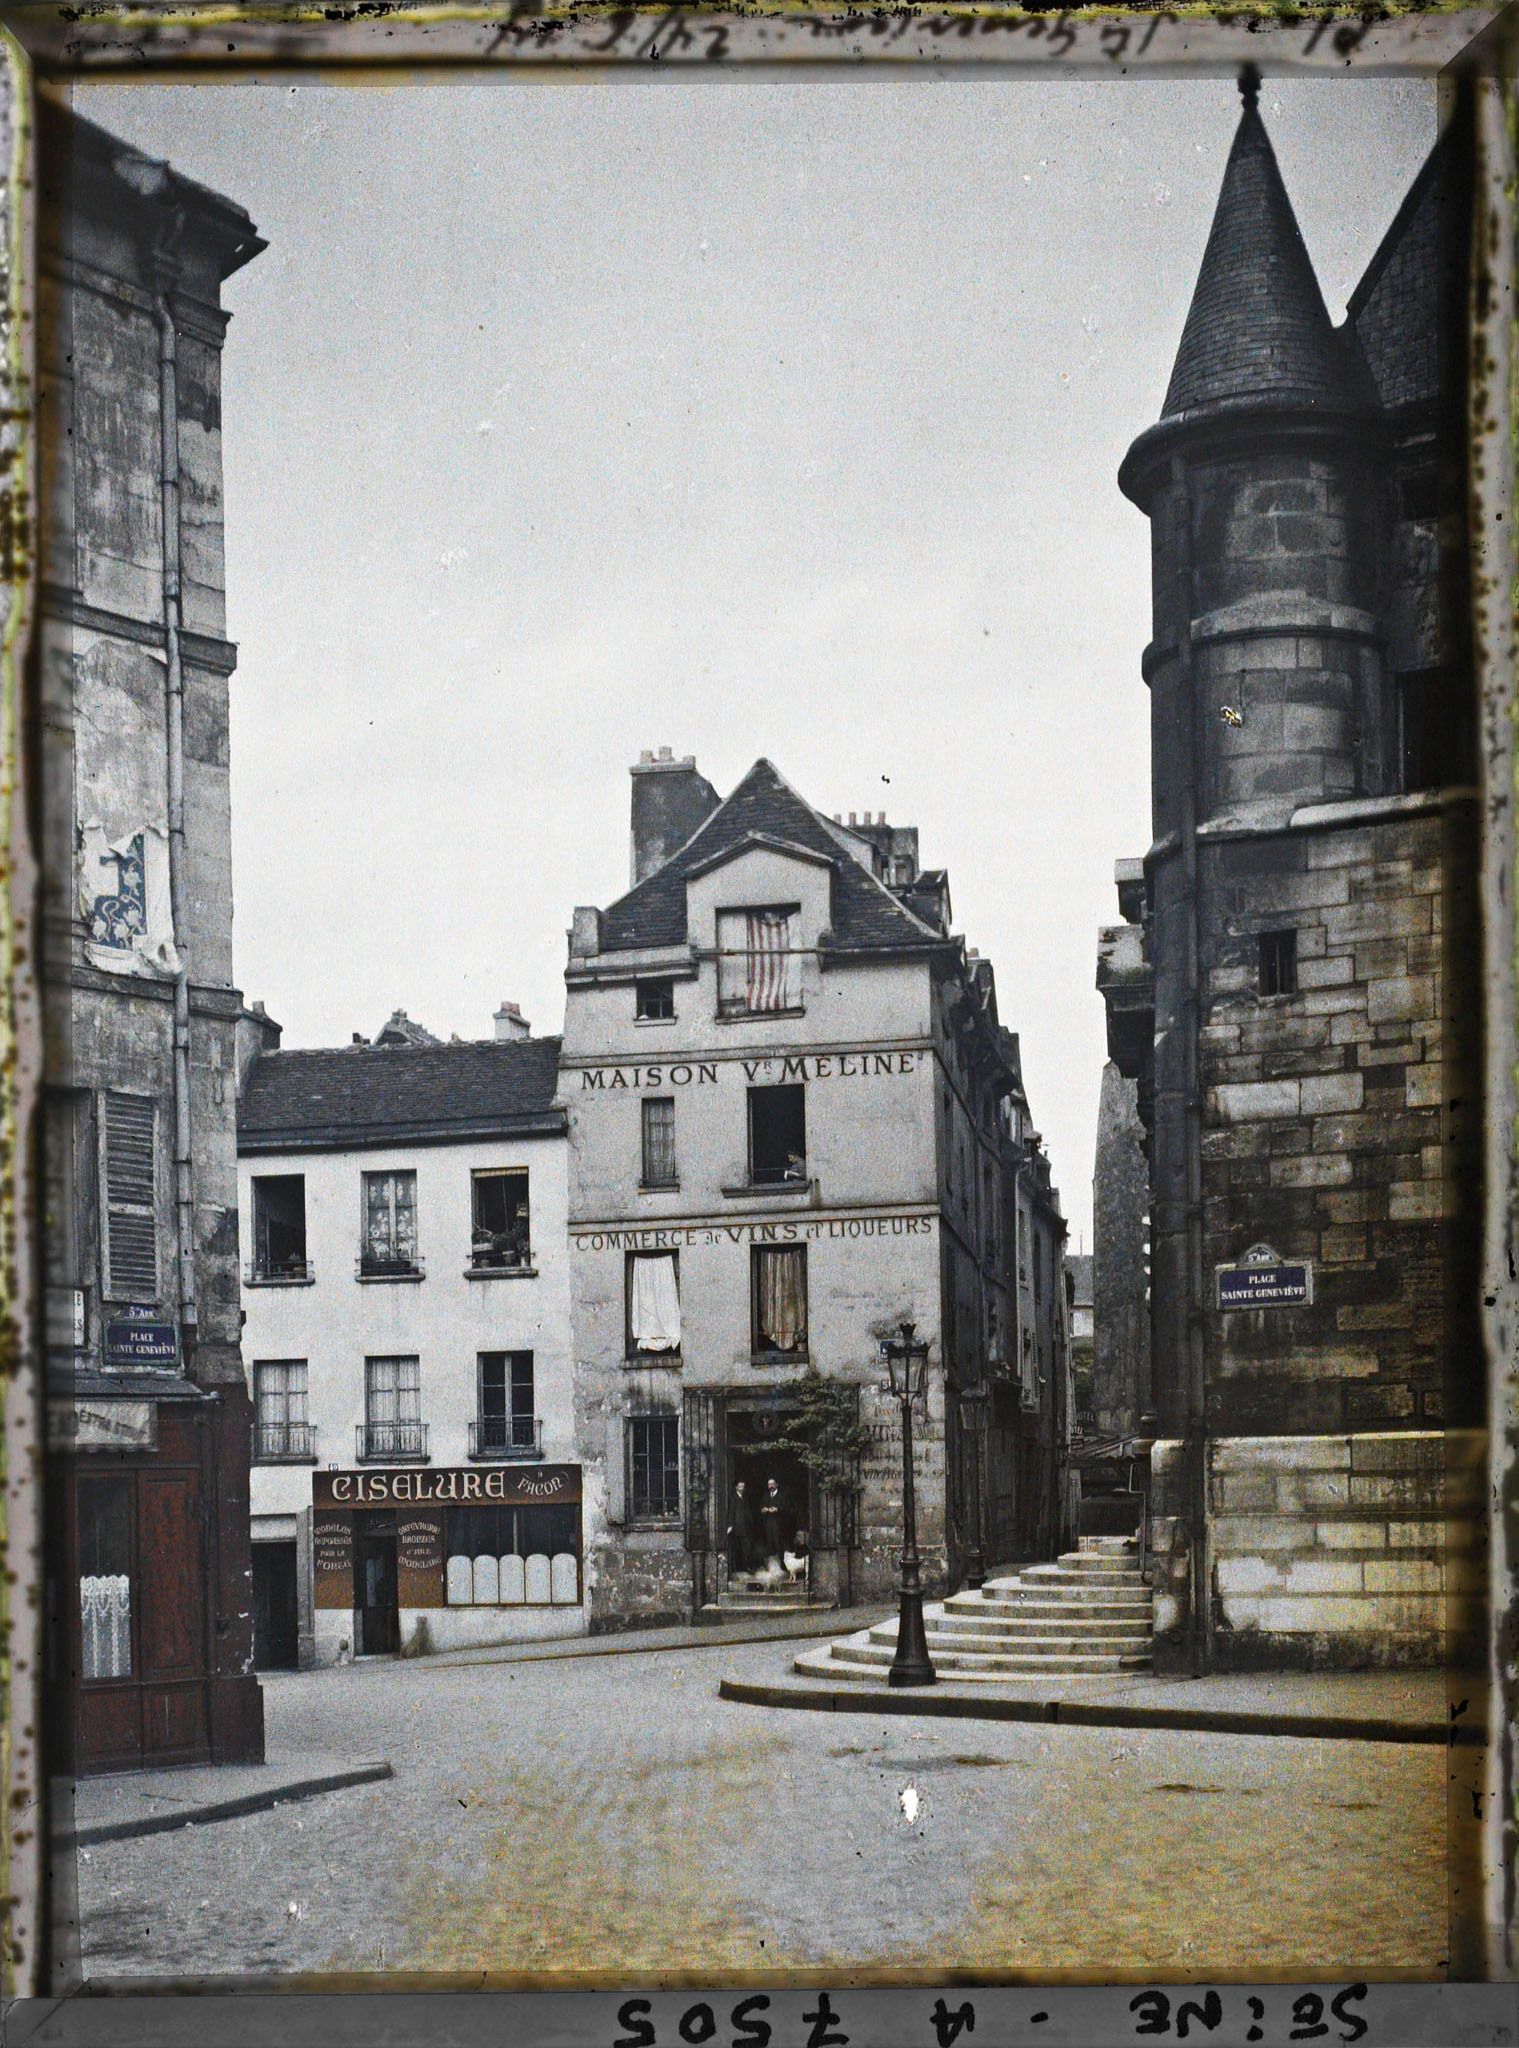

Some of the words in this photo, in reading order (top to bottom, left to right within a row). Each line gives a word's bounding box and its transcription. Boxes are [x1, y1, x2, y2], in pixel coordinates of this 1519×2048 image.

[581, 1063, 718, 1090] MAISON
[576, 1230, 697, 1252] COMMERCE
[724, 1223, 798, 1244] VINS
[828, 1217, 932, 1239] LIQUEURS
[1249, 1274, 1276, 1285] PLACE
[1221, 1290, 1254, 1300] SAINTE
[1255, 1286, 1306, 1298] GENEVIÈVE
[130, 1332, 154, 1342] PLACE
[108, 1344, 134, 1354] SAINTE
[136, 1342, 176, 1355] GENEVIÈVE
[332, 1470, 505, 1502] CISELURE
[932, 2000, 974, 2048] A
